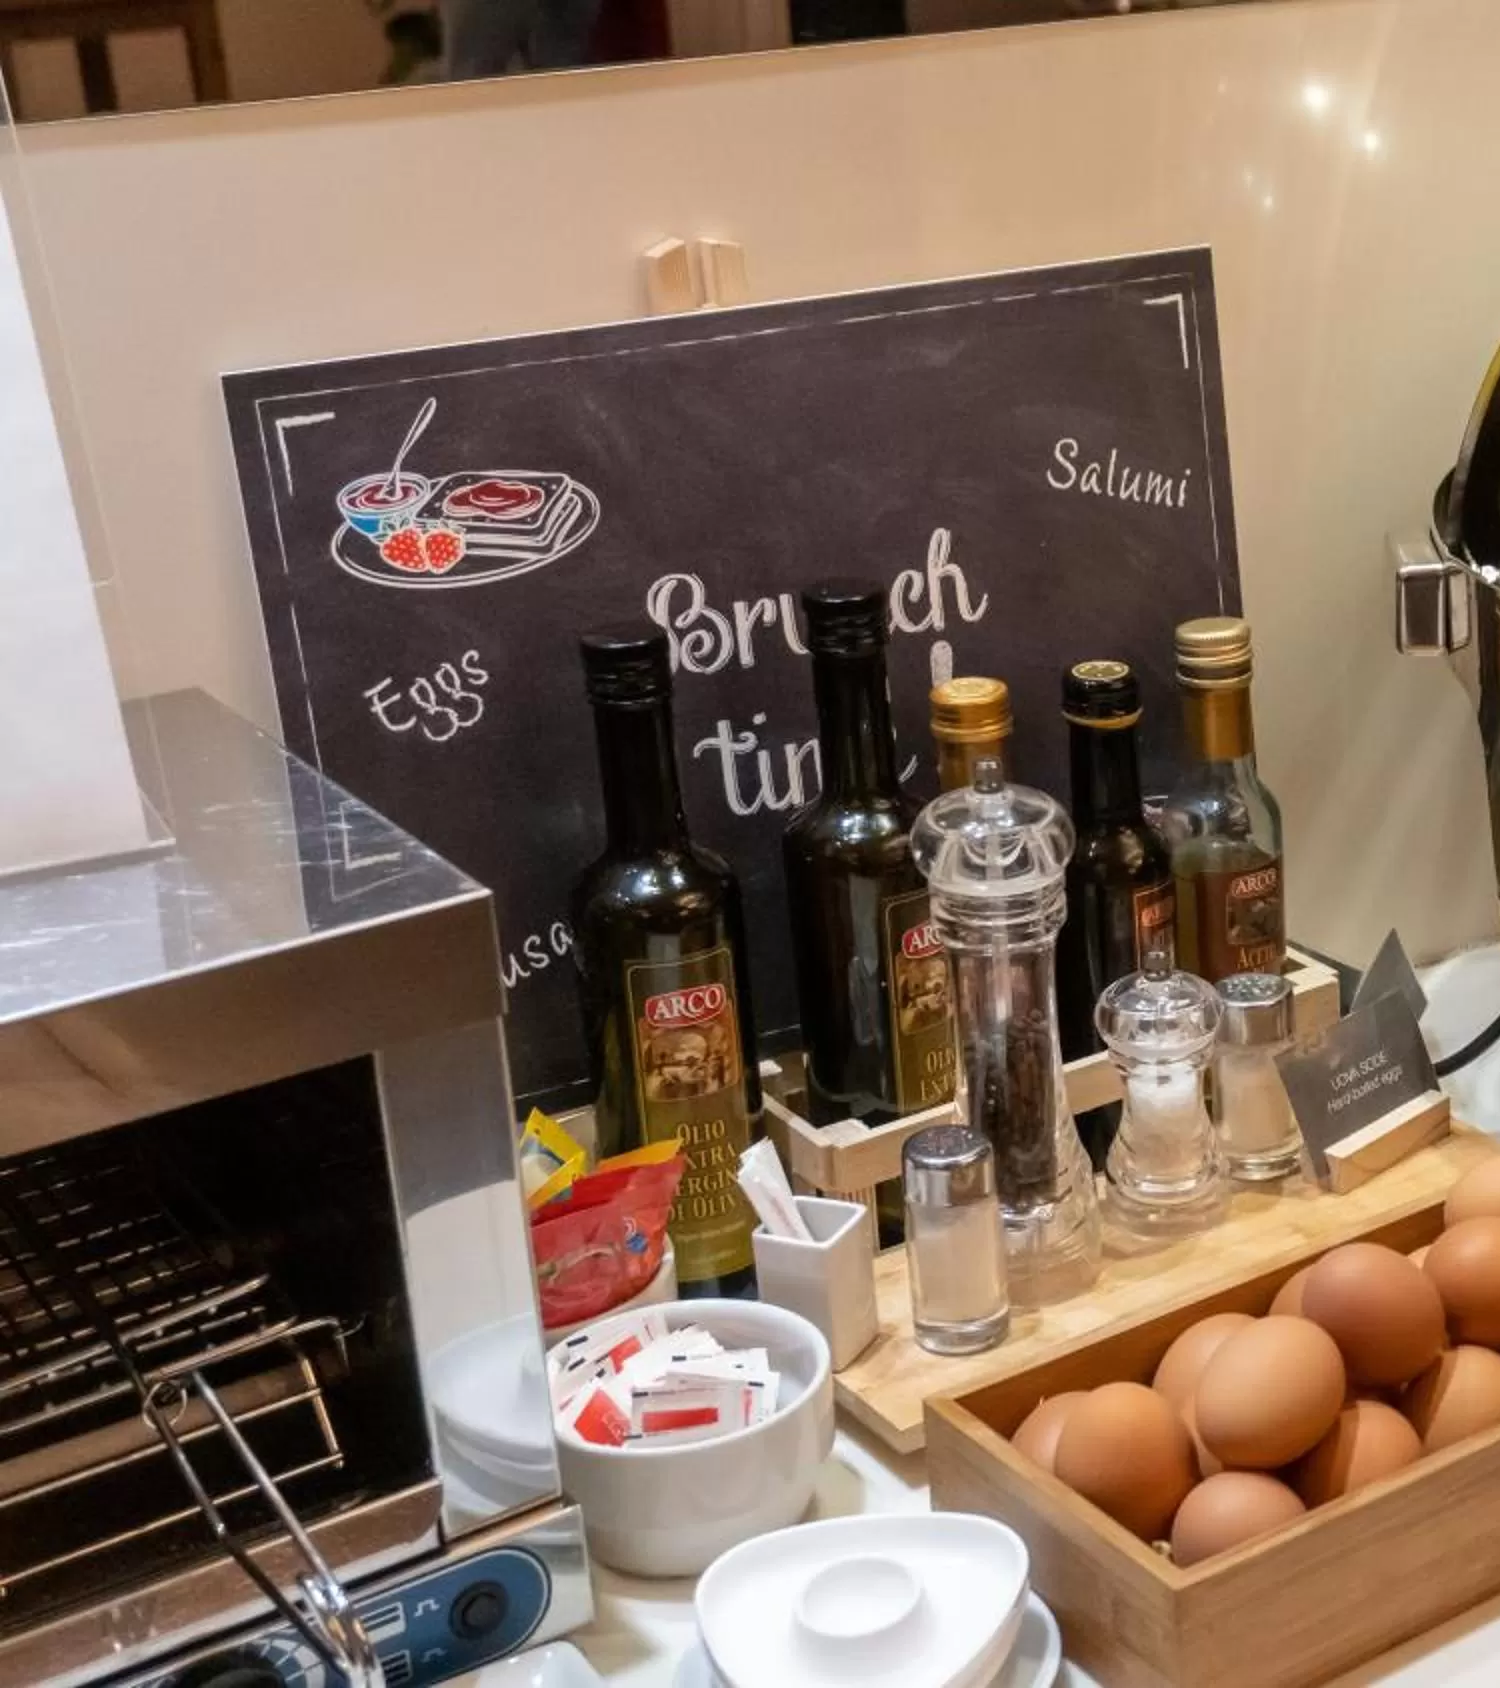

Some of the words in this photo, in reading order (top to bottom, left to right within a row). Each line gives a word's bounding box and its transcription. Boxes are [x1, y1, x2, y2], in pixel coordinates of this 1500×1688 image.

[1046, 437, 1192, 508] Salumi
[647, 527, 990, 675] Bruch
[362, 649, 490, 742] Eggs
[1236, 869, 1277, 896] ARCO
[653, 986, 721, 1020] ARCO
[676, 1119, 725, 1146] OLIO
[683, 1141, 737, 1170] XTRA
[675, 1167, 739, 1197] ERGIN
